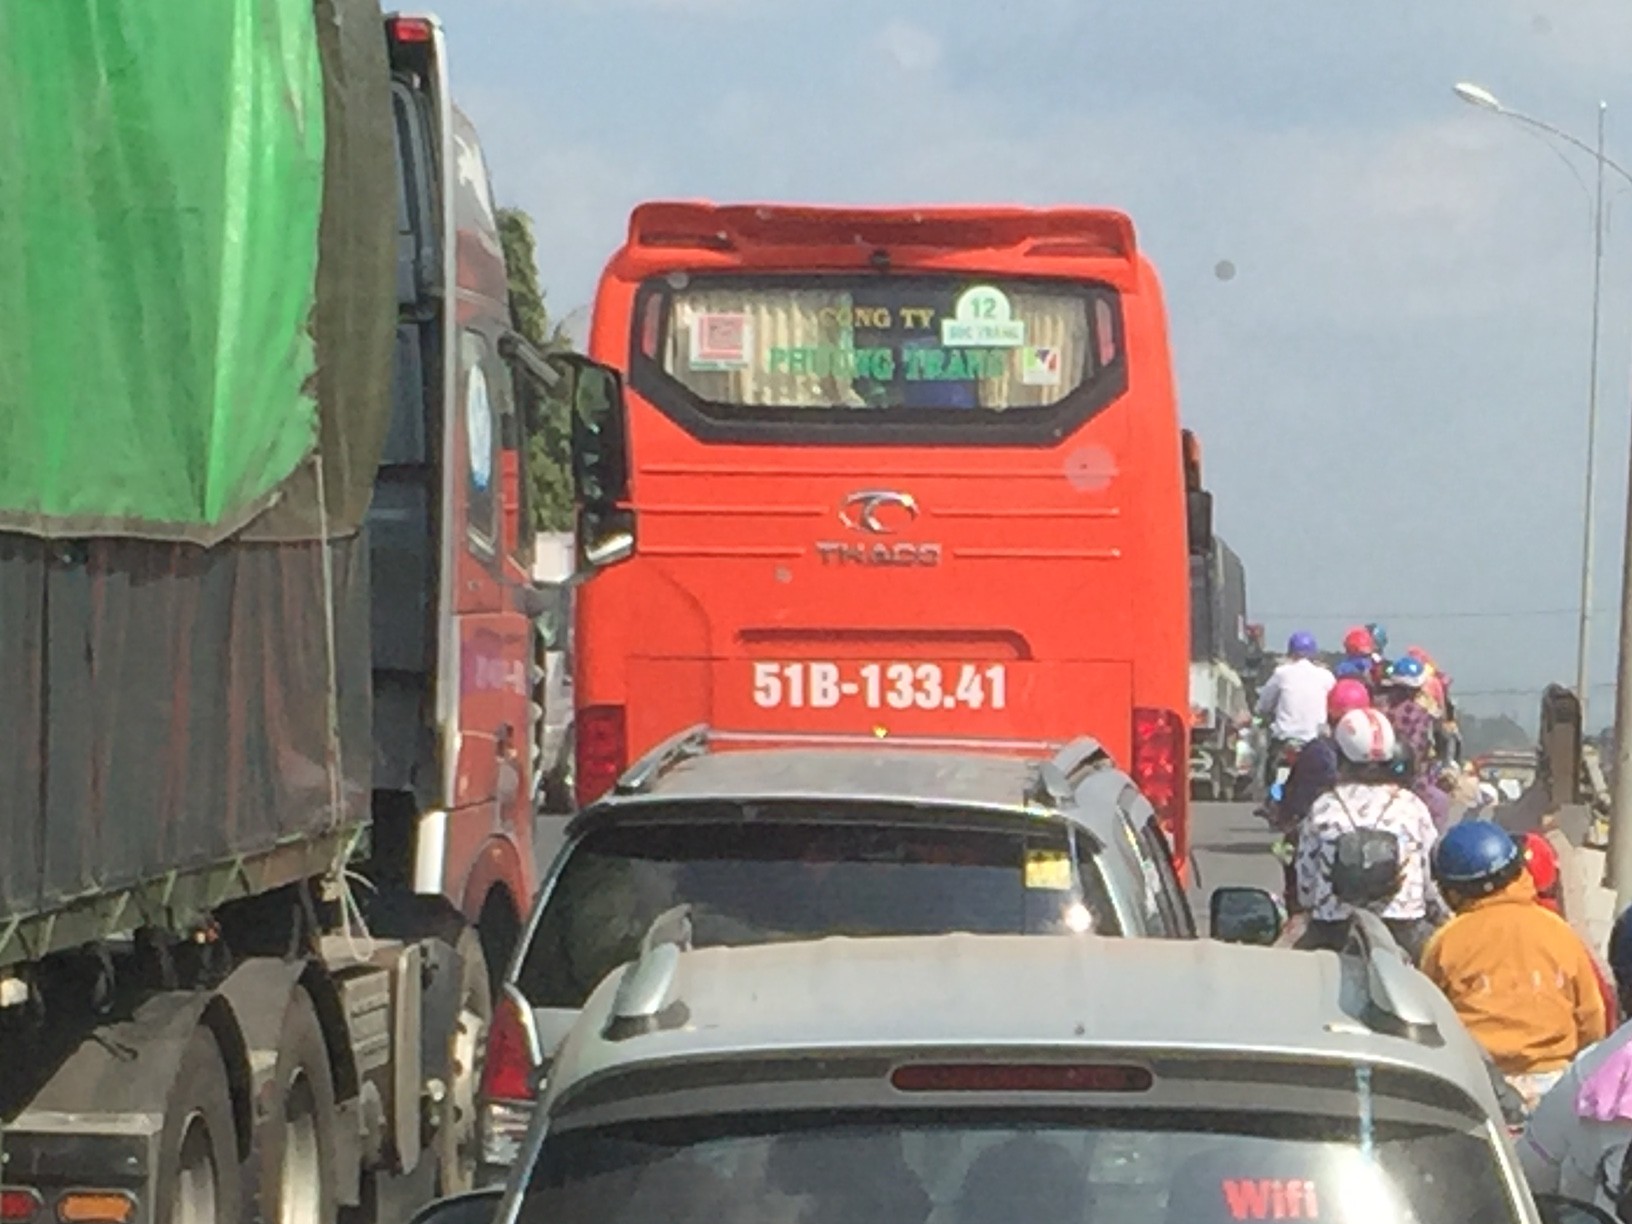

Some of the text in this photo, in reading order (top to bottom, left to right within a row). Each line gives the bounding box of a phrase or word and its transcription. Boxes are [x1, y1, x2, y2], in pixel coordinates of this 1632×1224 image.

[900, 306, 935, 329] TY
[971, 297, 996, 319] 12
[753, 661, 1006, 709] 51B-133.41
[1221, 1179, 1319, 1221] Wifi
